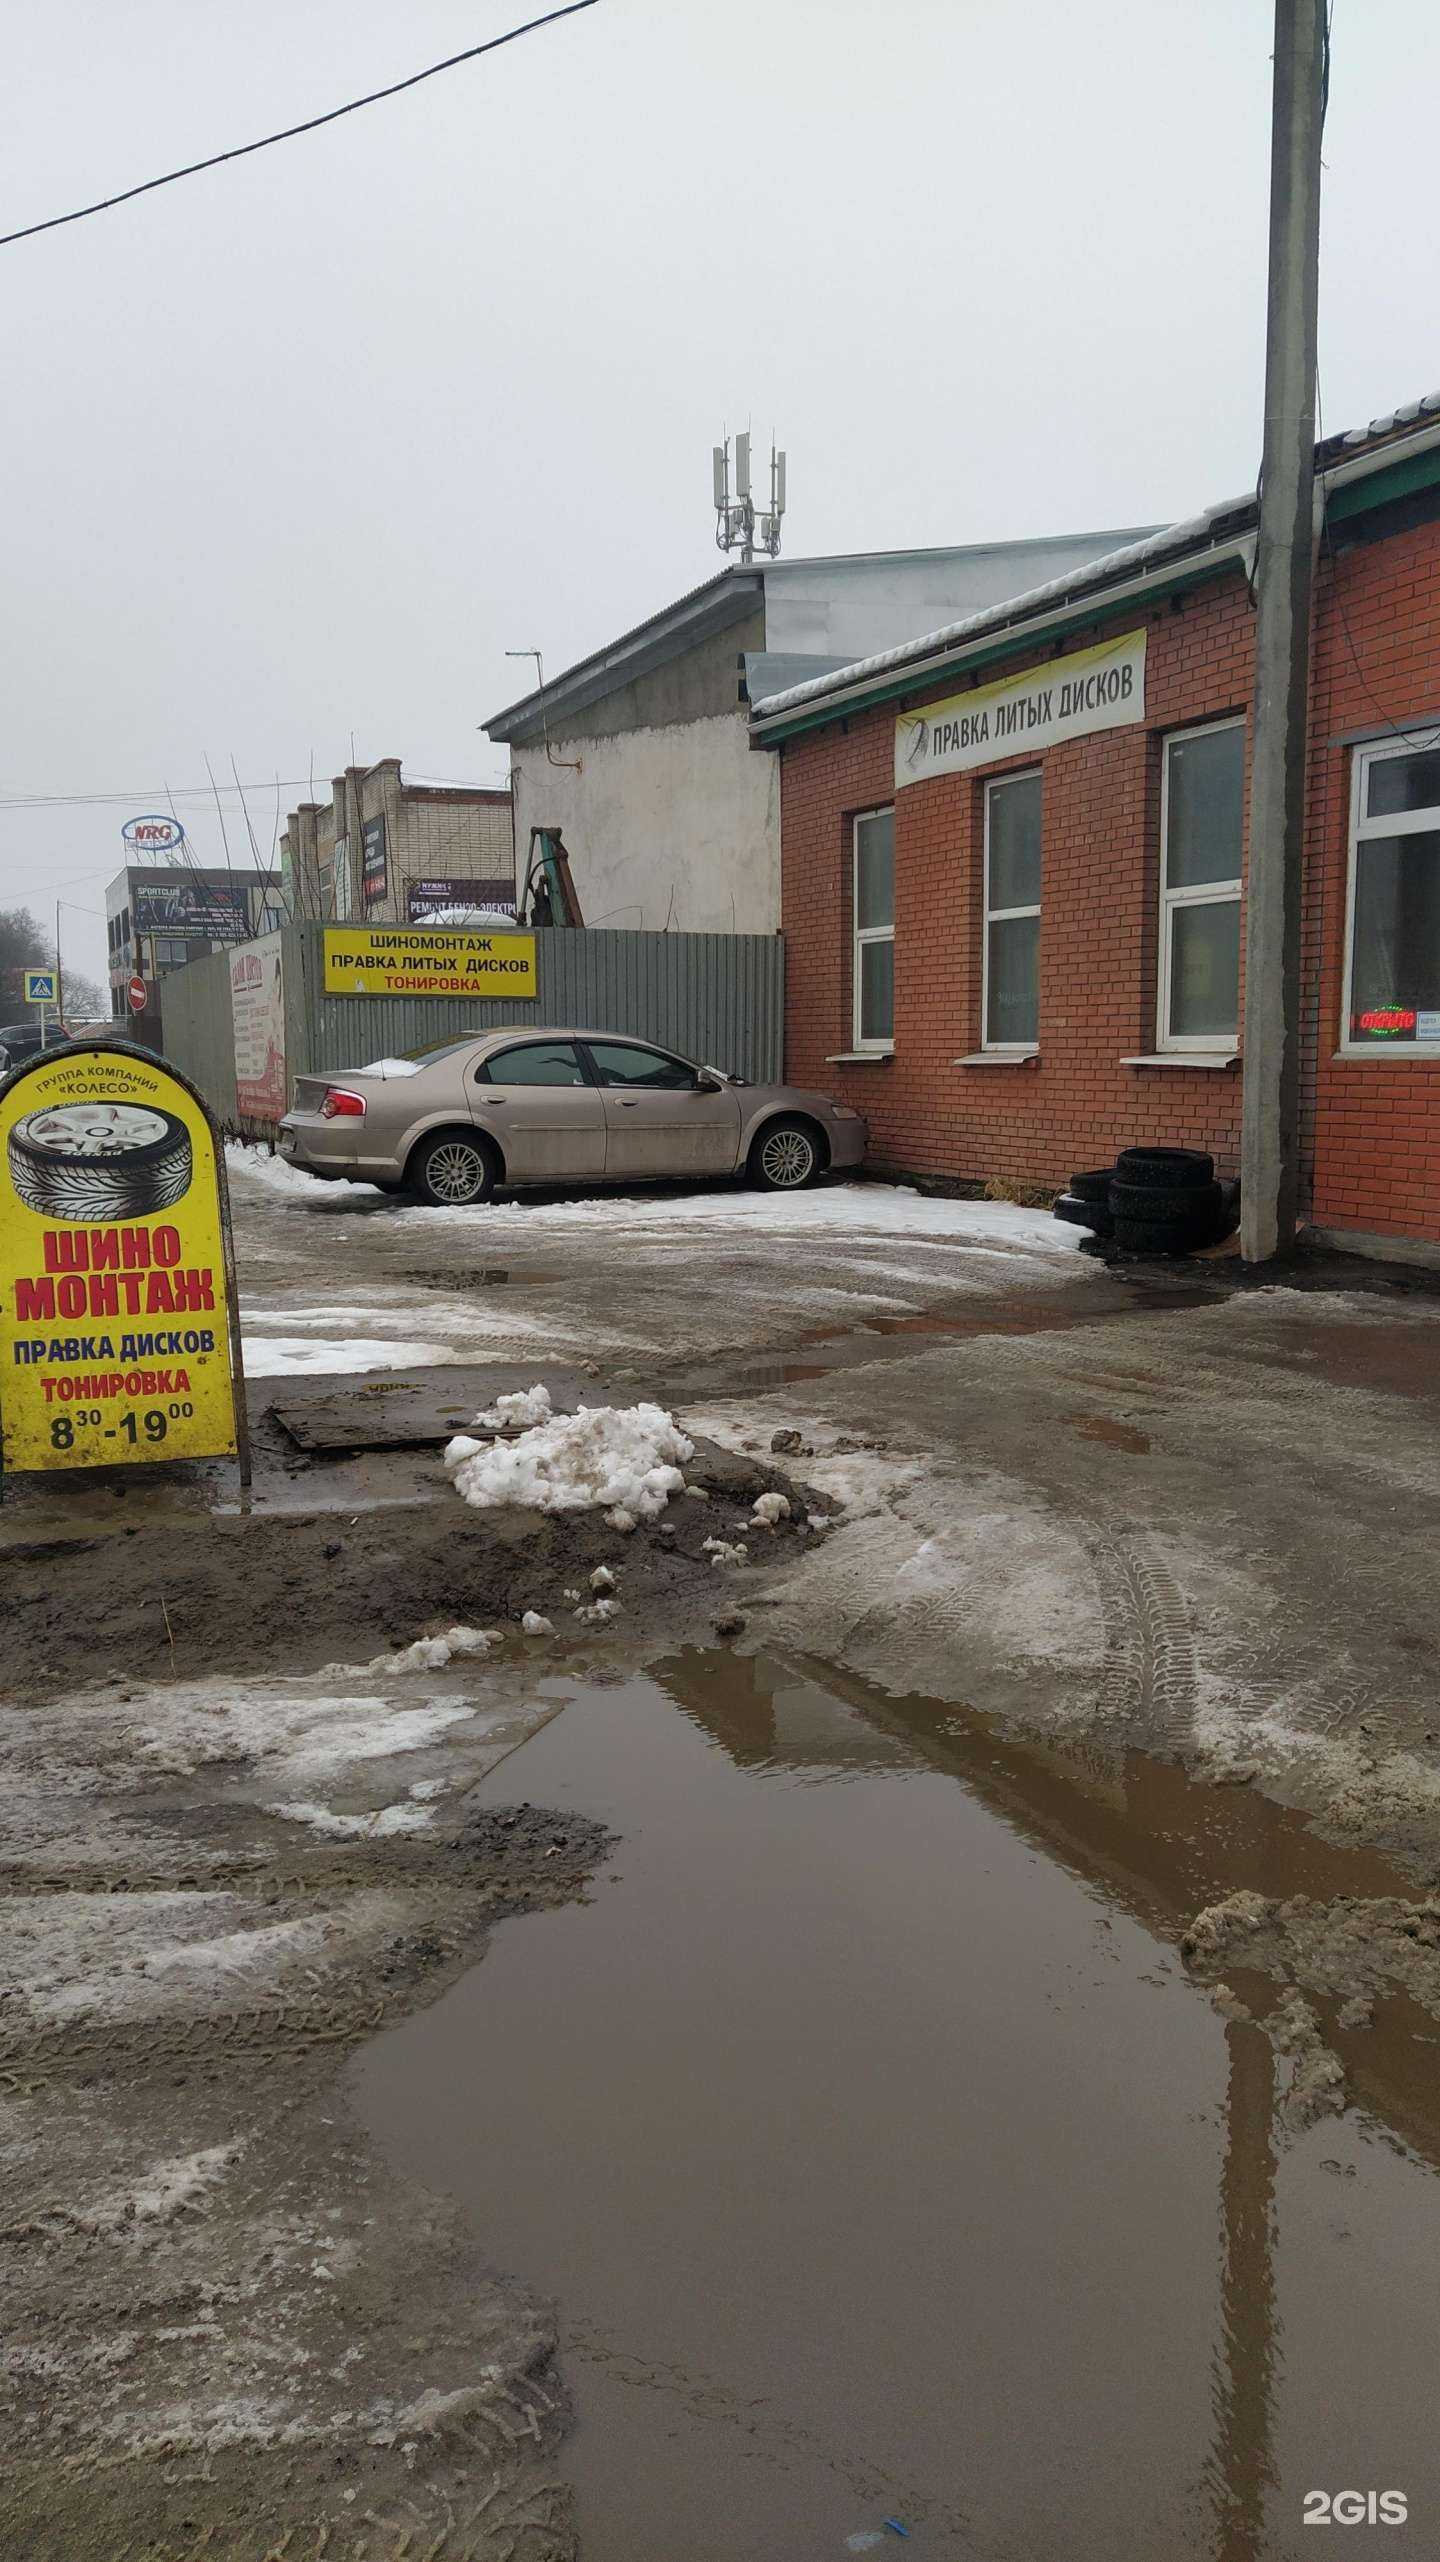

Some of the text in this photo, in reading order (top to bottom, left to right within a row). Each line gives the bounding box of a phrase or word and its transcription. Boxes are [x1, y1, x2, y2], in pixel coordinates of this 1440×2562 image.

[933, 664, 1134, 757] ПРАВКА ЛИТЫХ ДИСКОВ
[370, 934, 493, 952] ШИНОМОНТАЖ
[331, 954, 530, 974] ПРАВКА ЛИТЫХ ДИСКОВ
[384, 976, 481, 991] ТОНИРОВКА
[36, 1066, 160, 1093] ГРУППА КОМПАНИЙ
[59, 1082, 138, 1094] «КОЛЕСО»
[43, 1225, 182, 1274] ШИНО
[15, 1269, 216, 1322] МОНТАЖ
[14, 1330, 215, 1364] ПРАВКА ДИСКОВ
[40, 1368, 191, 1402] ТОНИРОВКА
